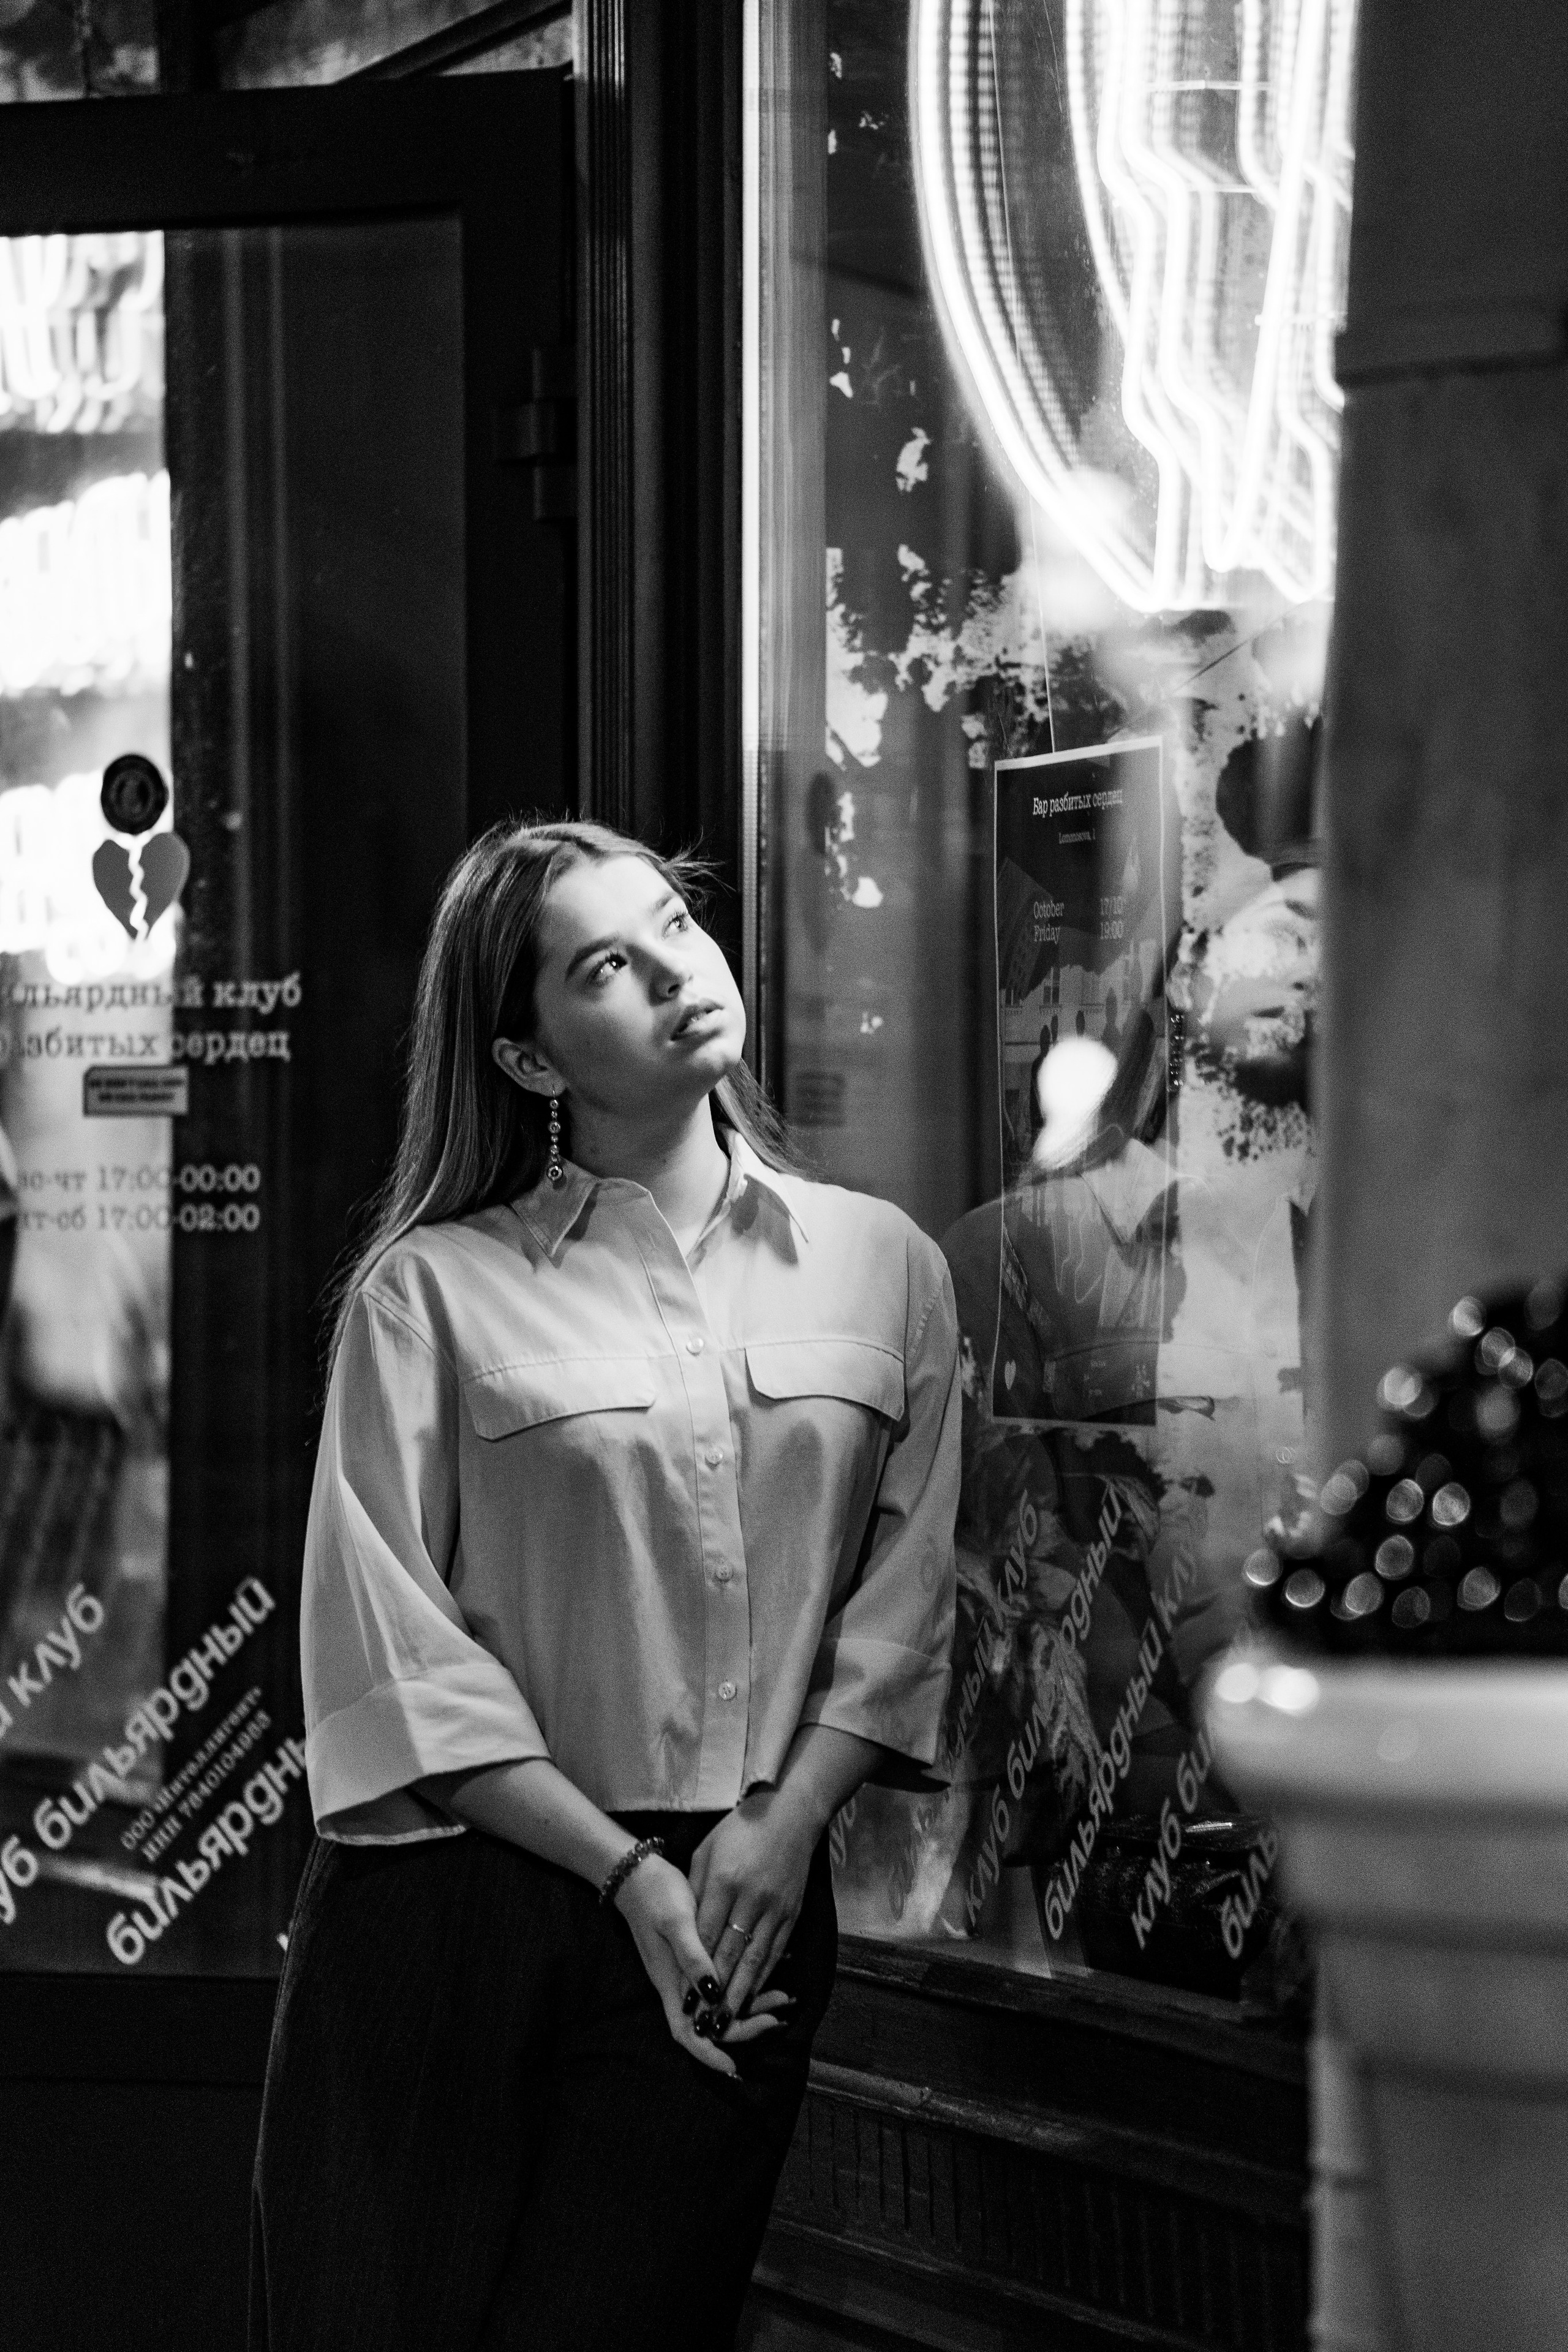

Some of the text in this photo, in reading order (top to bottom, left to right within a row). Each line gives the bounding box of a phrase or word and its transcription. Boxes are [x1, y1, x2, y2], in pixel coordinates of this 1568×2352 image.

[1033, 797, 1048, 818] Бар
[1049, 791, 1091, 817] разбитых
[1033, 900, 1065, 919] October
[1034, 923, 1061, 944] Friday
[212, 969, 304, 1015] клуб
[172, 1031, 293, 1066] сердец
[7, 1583, 105, 1707] клуб
[33, 1576, 276, 1850] бильярдный
[1045, 1617, 1164, 1940] бильярдный
[965, 1783, 1010, 1926] клуб
[1130, 1798, 1181, 1949] клуб
